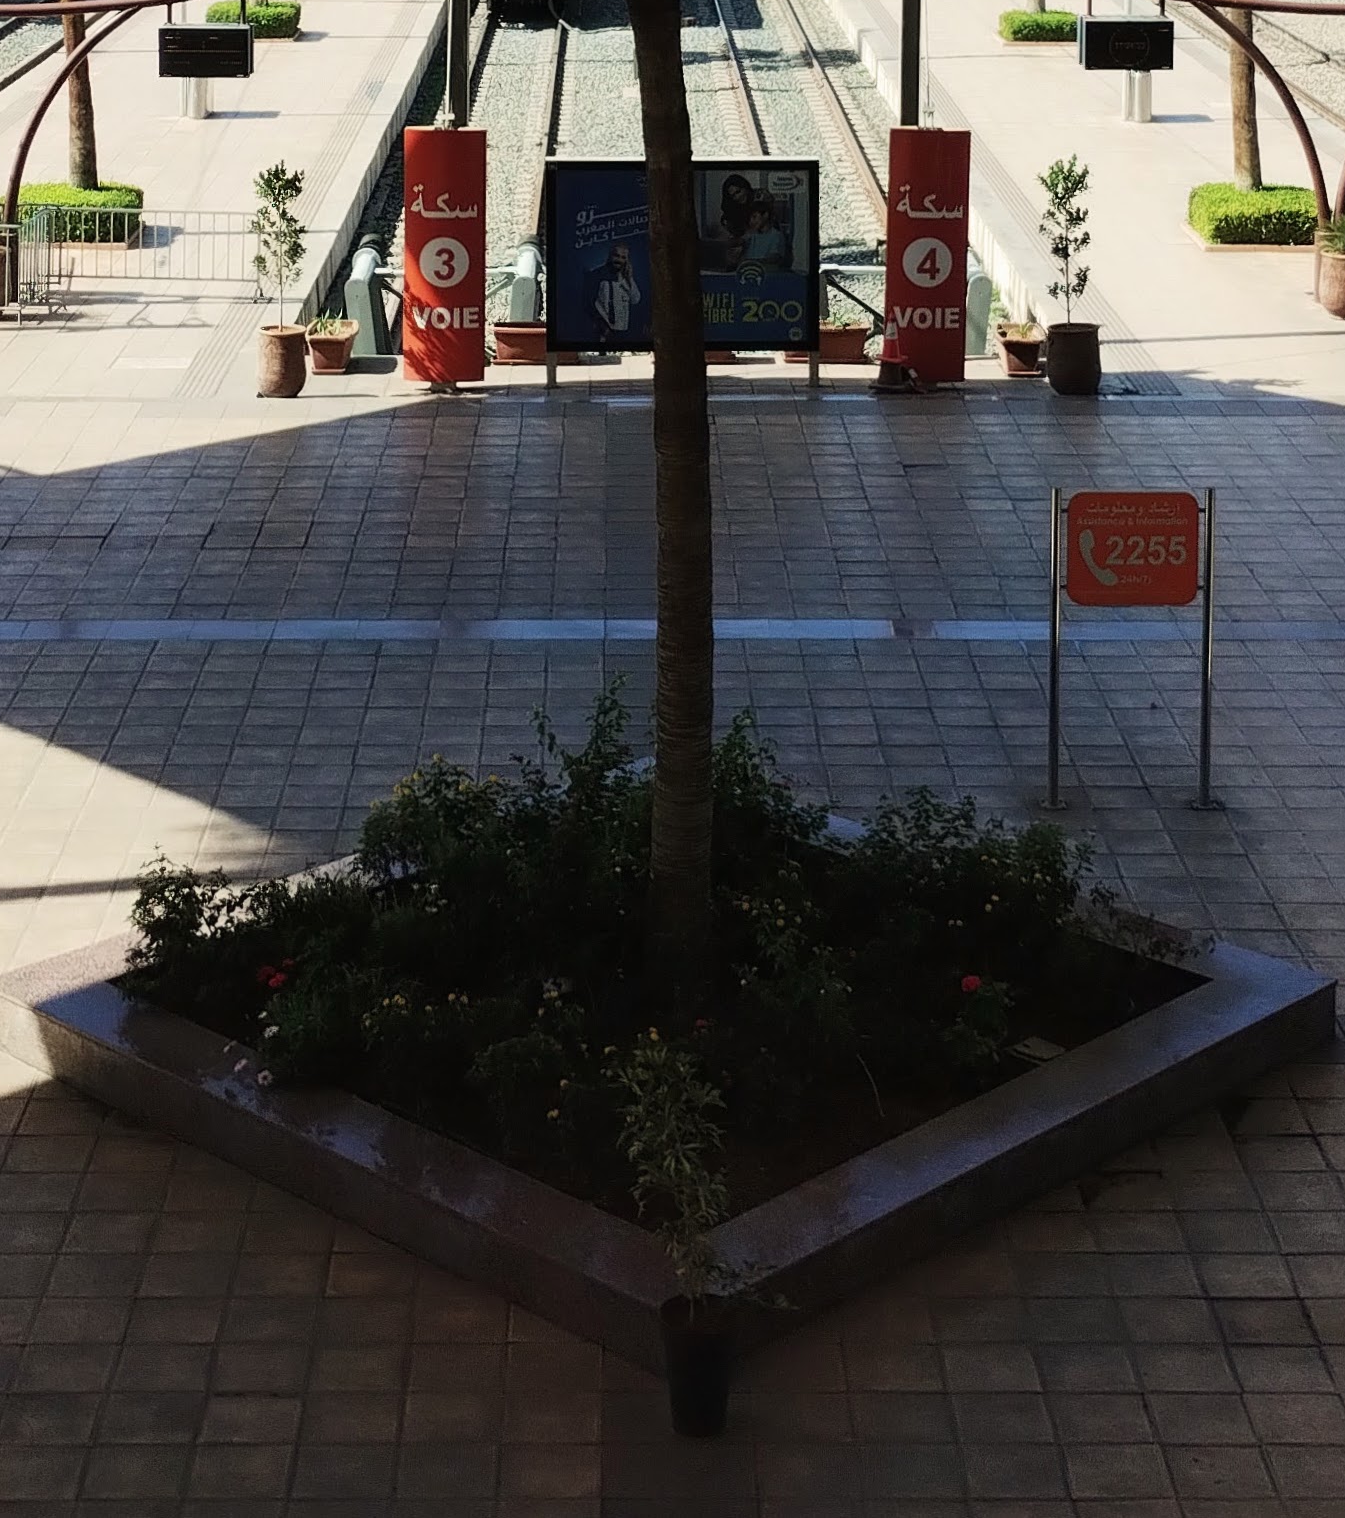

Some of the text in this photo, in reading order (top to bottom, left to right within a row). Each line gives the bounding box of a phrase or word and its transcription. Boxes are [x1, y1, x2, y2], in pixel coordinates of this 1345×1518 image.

[410, 184, 478, 219] سكة
[896, 184, 963, 219] سكة
[576, 220, 615, 239] المغرب
[433, 247, 455, 280] 3
[917, 247, 940, 280] 4
[703, 292, 735, 308] WIFI
[742, 300, 803, 323] 200
[412, 305, 480, 330] VOIE
[703, 308, 735, 324] FIBRE
[893, 306, 960, 330] VOIE
[1076, 516, 1126, 526] Assistance
[1136, 516, 1189, 526] Information
[1106, 535, 1188, 566] 2255
